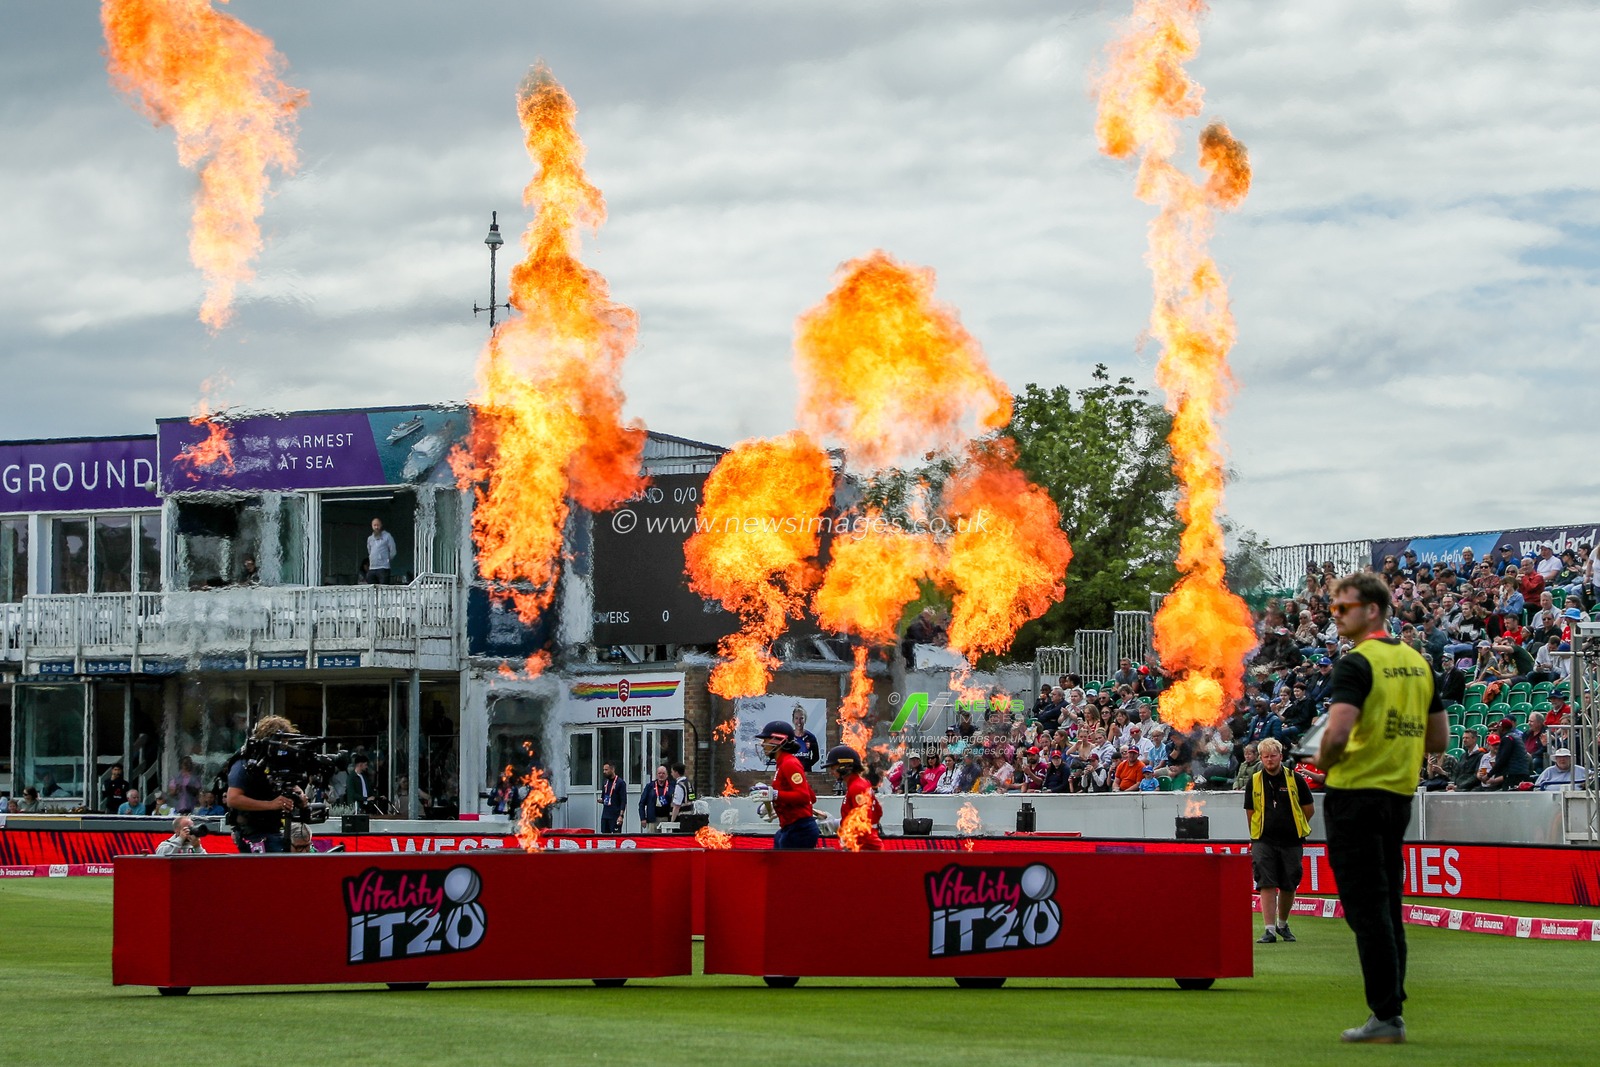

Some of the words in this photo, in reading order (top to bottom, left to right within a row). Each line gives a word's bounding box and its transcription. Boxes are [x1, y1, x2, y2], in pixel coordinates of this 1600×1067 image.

[281, 455, 299, 470] AT
[305, 455, 335, 469] SEA
[3, 458, 153, 494] GROUND
[674, 487, 697, 504] 0/0
[1519, 528, 1597, 557] wodland
[1421, 551, 1438, 564] We
[662, 610, 670, 622] 0
[597, 707, 610, 718] FLY
[611, 705, 652, 718] TOGETHER
[6, 867, 34, 876] insurance
[87, 865, 98, 874] Life
[348, 870, 444, 917] Vitality
[930, 866, 1021, 914] Vitality
[932, 898, 1060, 955] IT20
[1474, 916, 1483, 928] Life
[1483, 918, 1504, 930] insurance
[1541, 923, 1556, 935] Health
[1557, 924, 1579, 936] insurance
[350, 901, 485, 962] IT20
